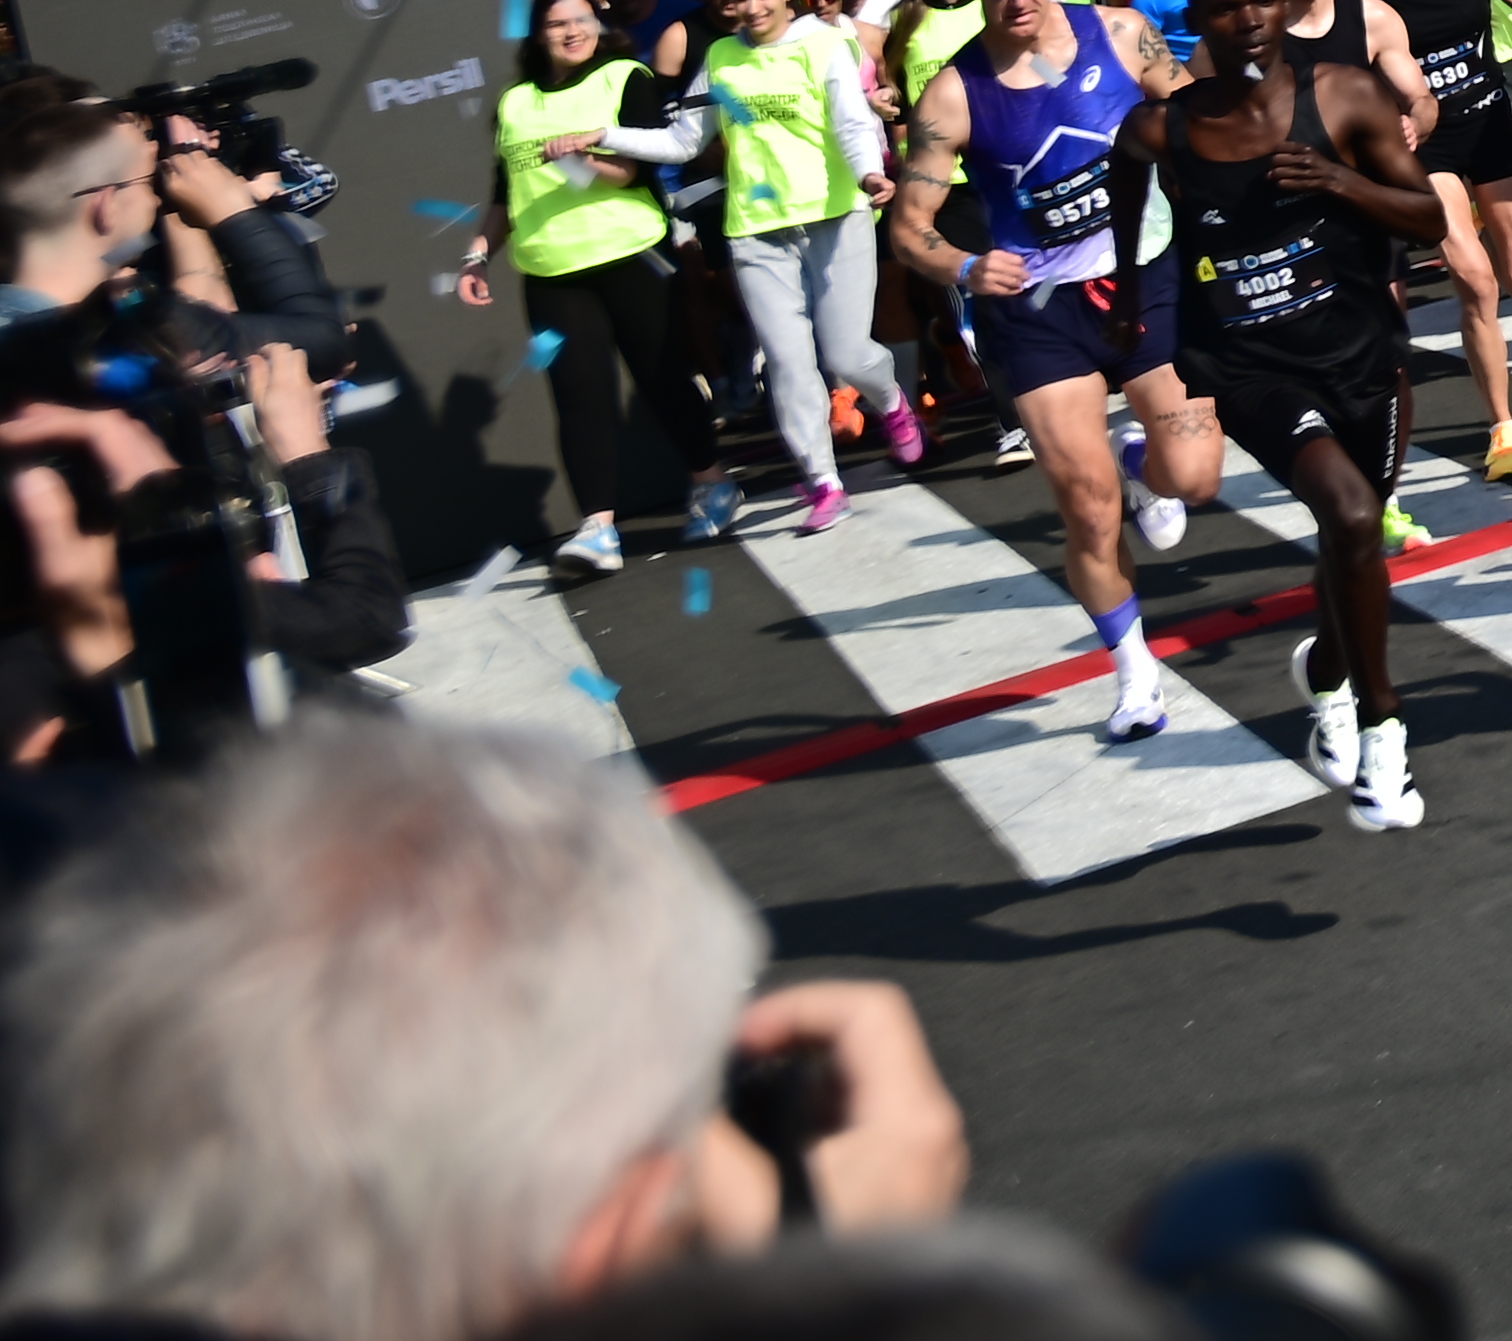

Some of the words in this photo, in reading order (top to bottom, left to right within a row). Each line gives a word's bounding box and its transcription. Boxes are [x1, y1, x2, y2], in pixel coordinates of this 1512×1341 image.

[365, 57, 486, 113] Persil
[1044, 187, 1111, 228] 9573
[1236, 267, 1296, 296] 4002
